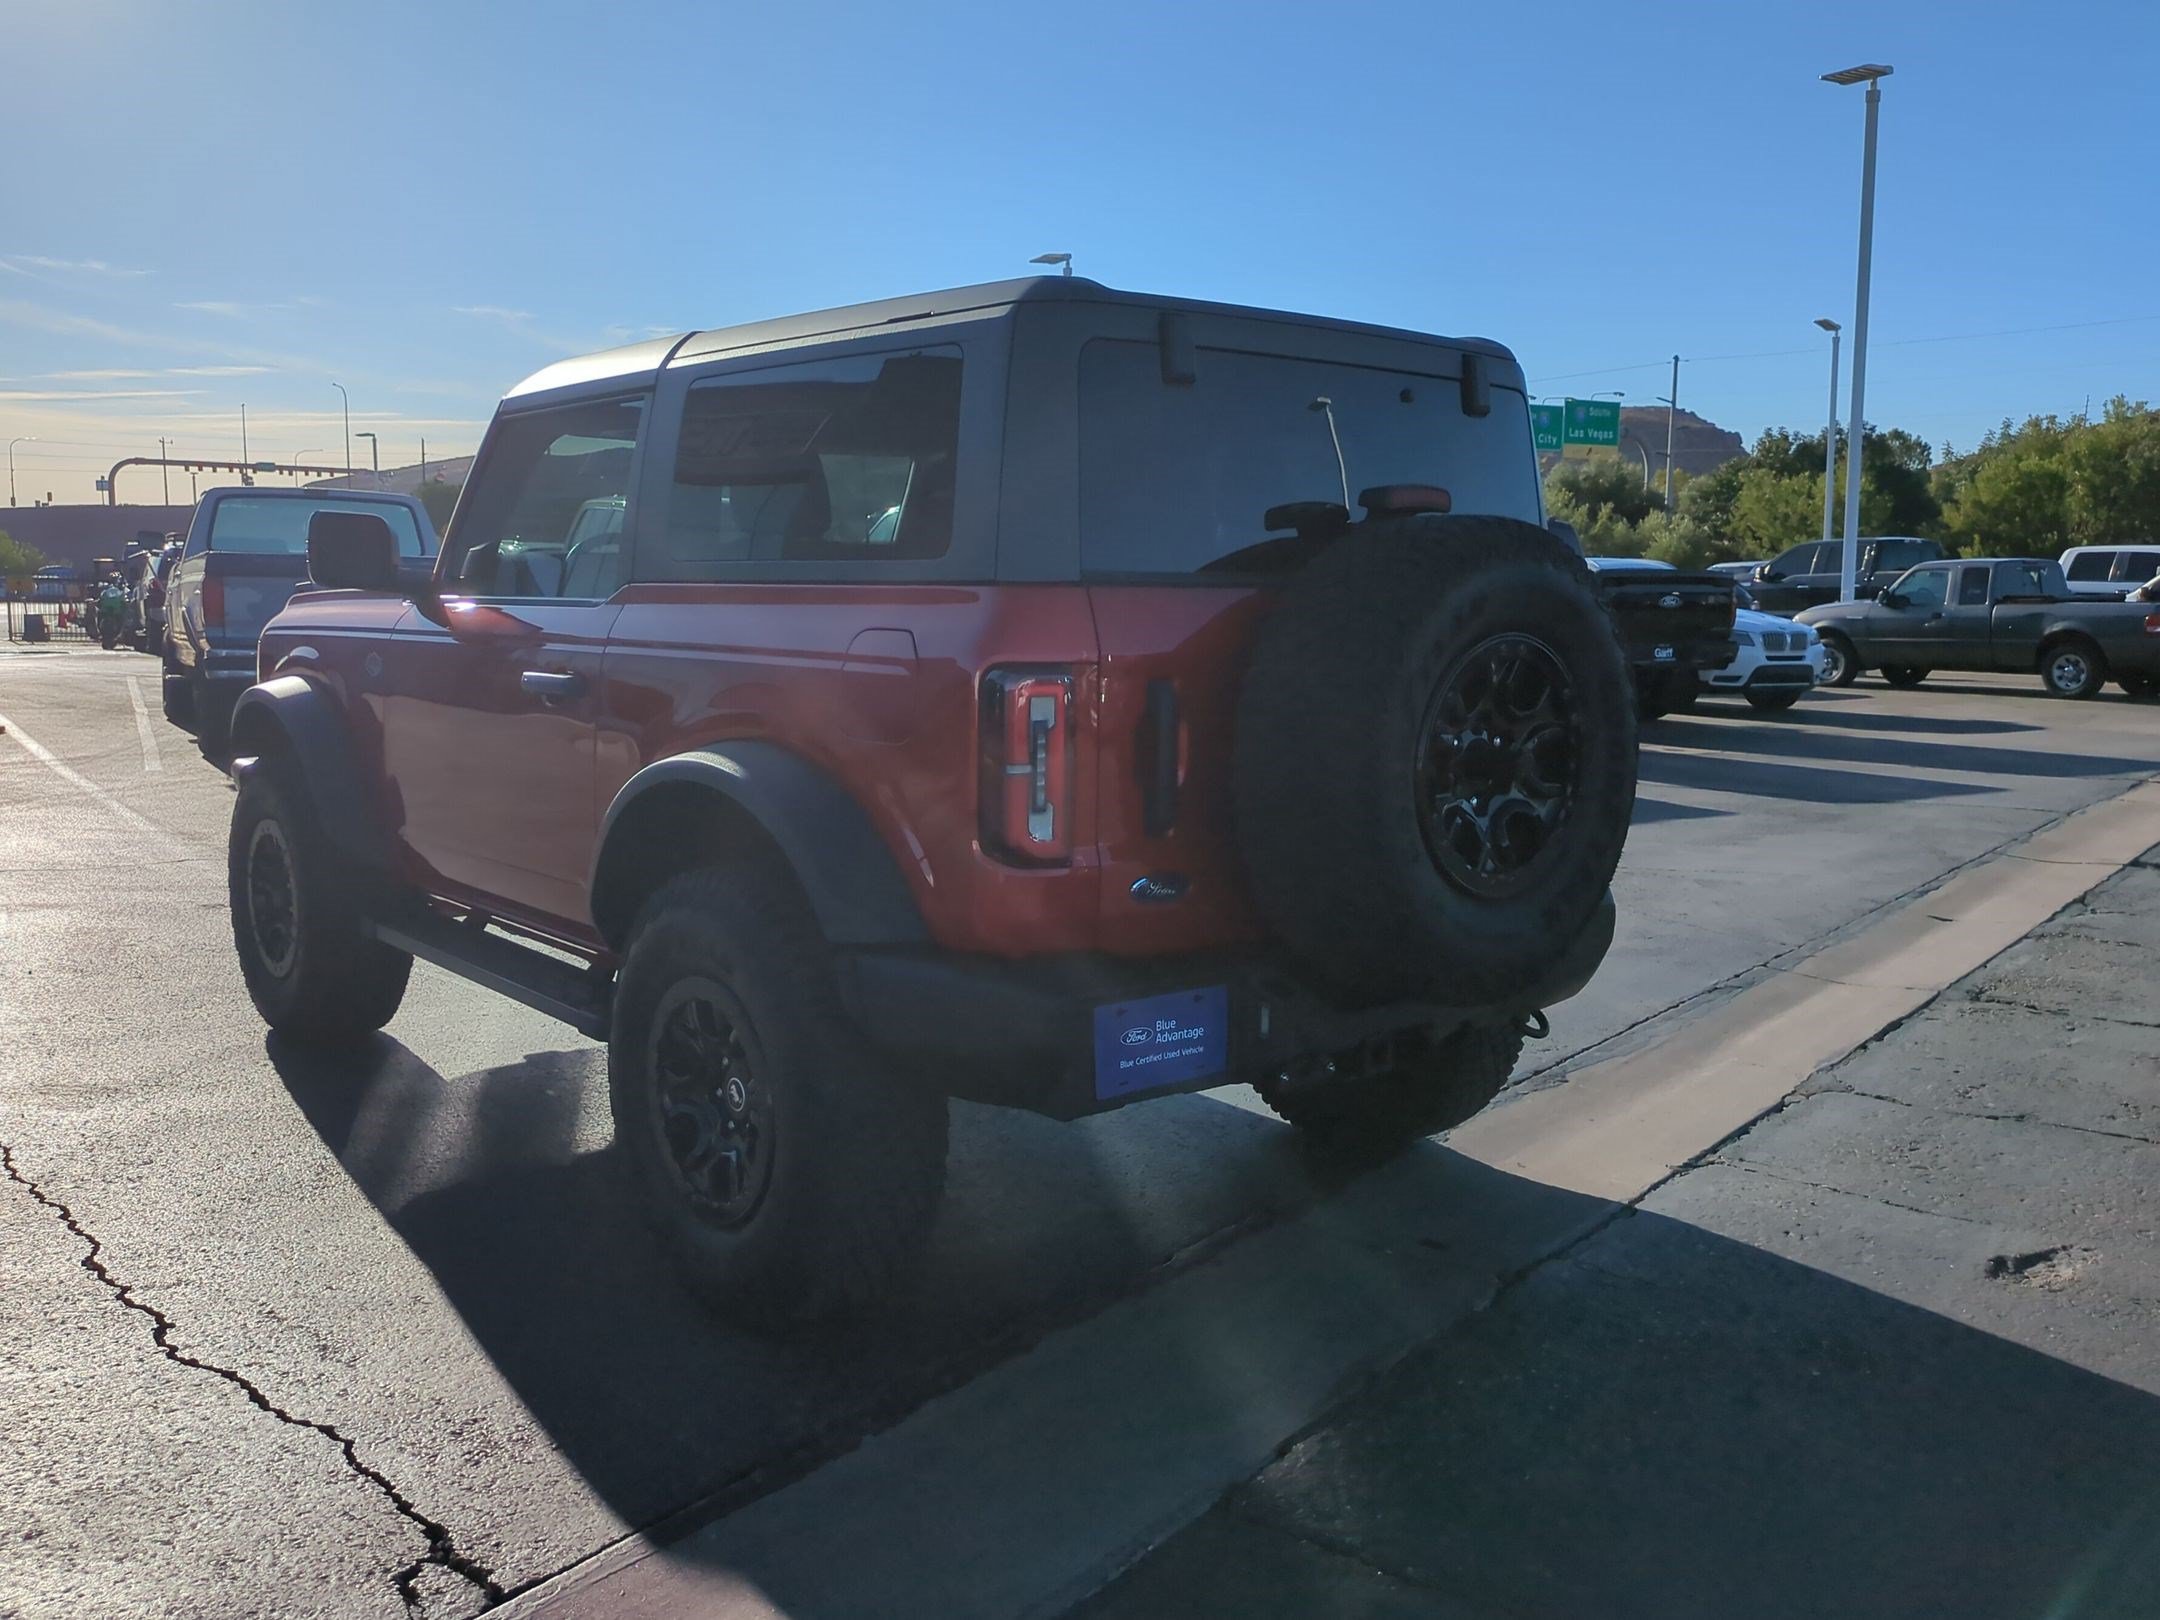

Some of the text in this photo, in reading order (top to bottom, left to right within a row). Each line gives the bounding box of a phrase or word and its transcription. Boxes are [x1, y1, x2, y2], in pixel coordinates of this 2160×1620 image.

[1538, 433, 1558, 446] City
[1569, 427, 1614, 441] Las Vegas
[1155, 1019, 1177, 1032] Blue
[1125, 1029, 1148, 1044] Ford
[1155, 1026, 1205, 1044] Advantage
[1119, 1045, 1205, 1069] Blue Certified Used Vehicle
